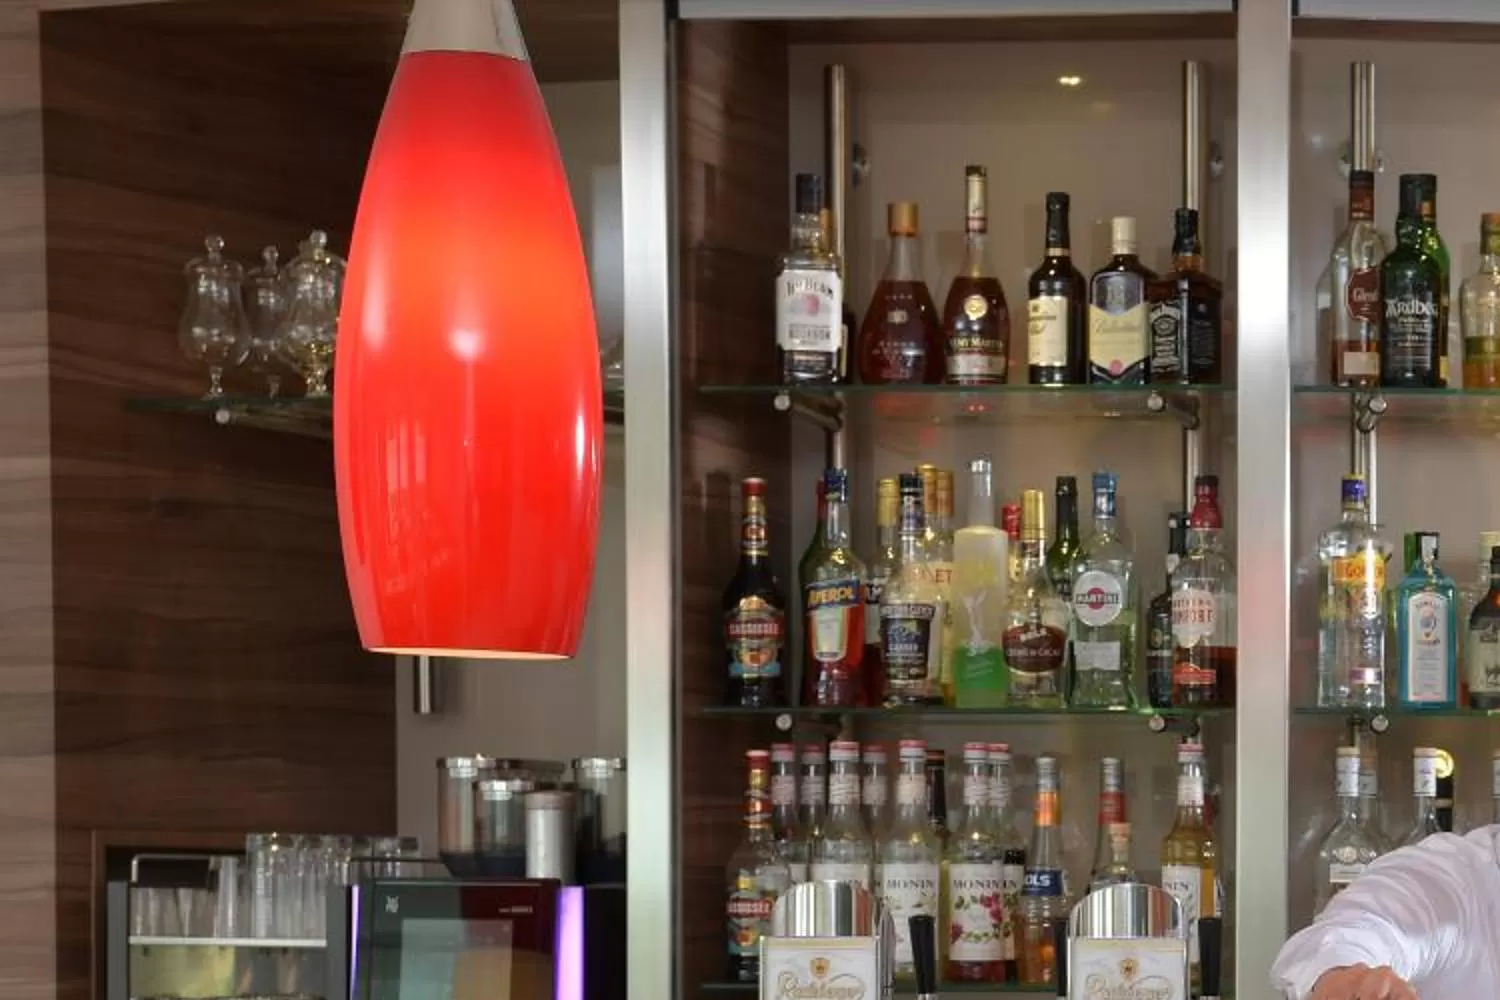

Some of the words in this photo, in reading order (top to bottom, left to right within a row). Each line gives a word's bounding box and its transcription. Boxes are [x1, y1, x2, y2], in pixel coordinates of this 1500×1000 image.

[808, 586, 854, 605] APEROL
[1076, 593, 1119, 605] MARTINI
[887, 879, 934, 889] MONIN
